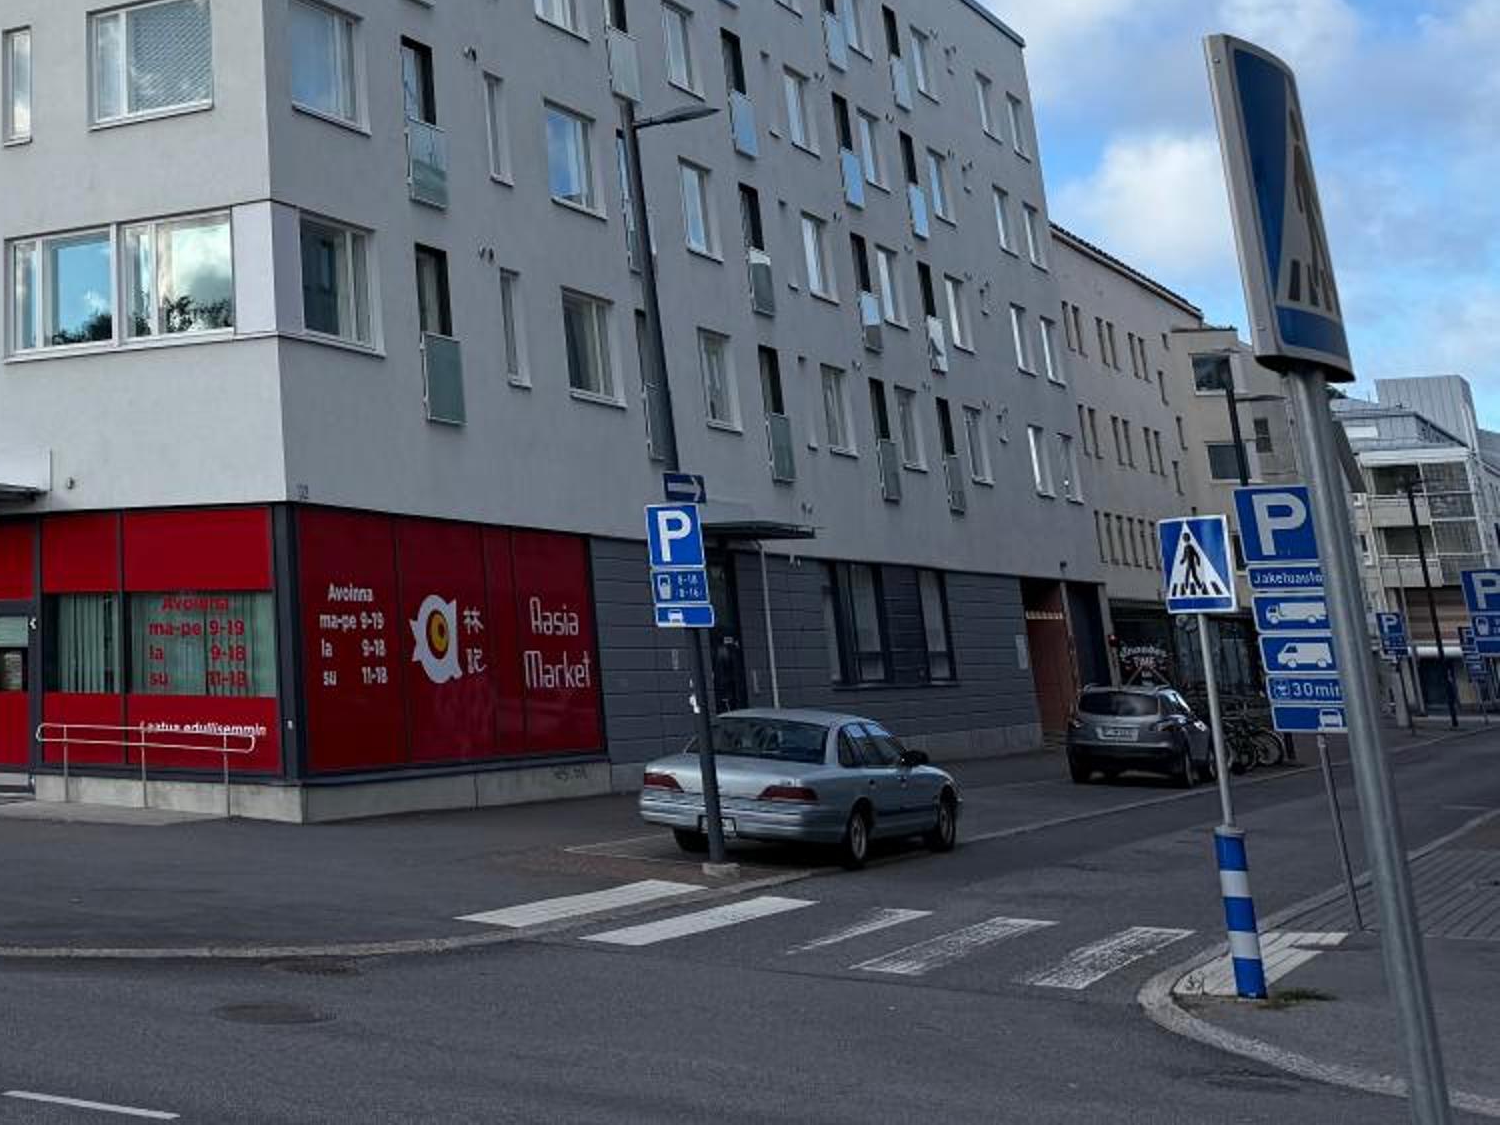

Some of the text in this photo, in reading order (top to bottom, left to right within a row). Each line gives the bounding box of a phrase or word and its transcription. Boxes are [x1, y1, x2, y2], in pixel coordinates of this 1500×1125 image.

[1252, 492, 1308, 555] P
[657, 510, 691, 562] P
[328, 583, 374, 602] Avoinna
[1471, 572, 1500, 609] P
[319, 614, 356, 632] ma-pe
[529, 596, 579, 635] Aasia
[1381, 615, 1397, 633] P
[148, 619, 245, 638] ma-pe 9-19
[321, 638, 333, 657] la
[323, 670, 337, 686] su
[524, 650, 591, 689] Market
[1292, 682, 1314, 697] 30
